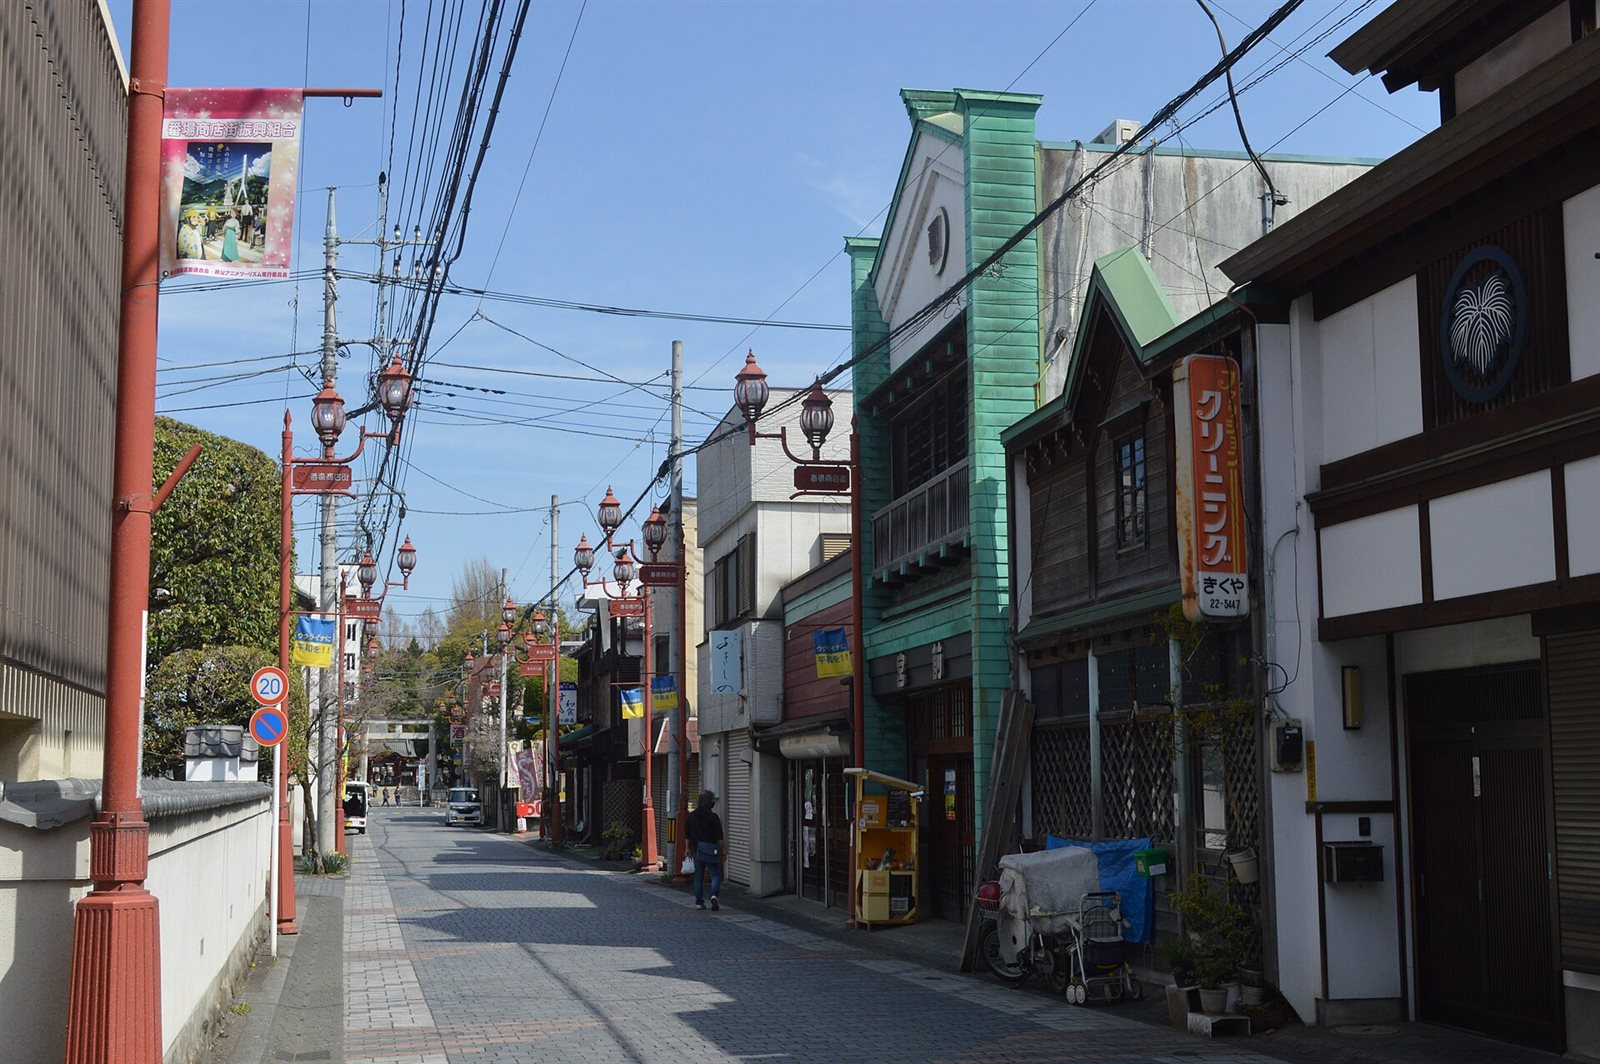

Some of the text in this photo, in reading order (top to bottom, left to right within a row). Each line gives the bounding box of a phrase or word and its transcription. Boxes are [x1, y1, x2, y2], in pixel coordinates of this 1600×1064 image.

[167, 120, 297, 138] 番場商店街振興組合
[1196, 390, 1232, 566] クリーニング
[1203, 576, 1244, 595] きくや
[1209, 598, 1241, 610] 22-5447
[297, 632, 332, 642] ウクライナに
[259, 678, 280, 695] 20
